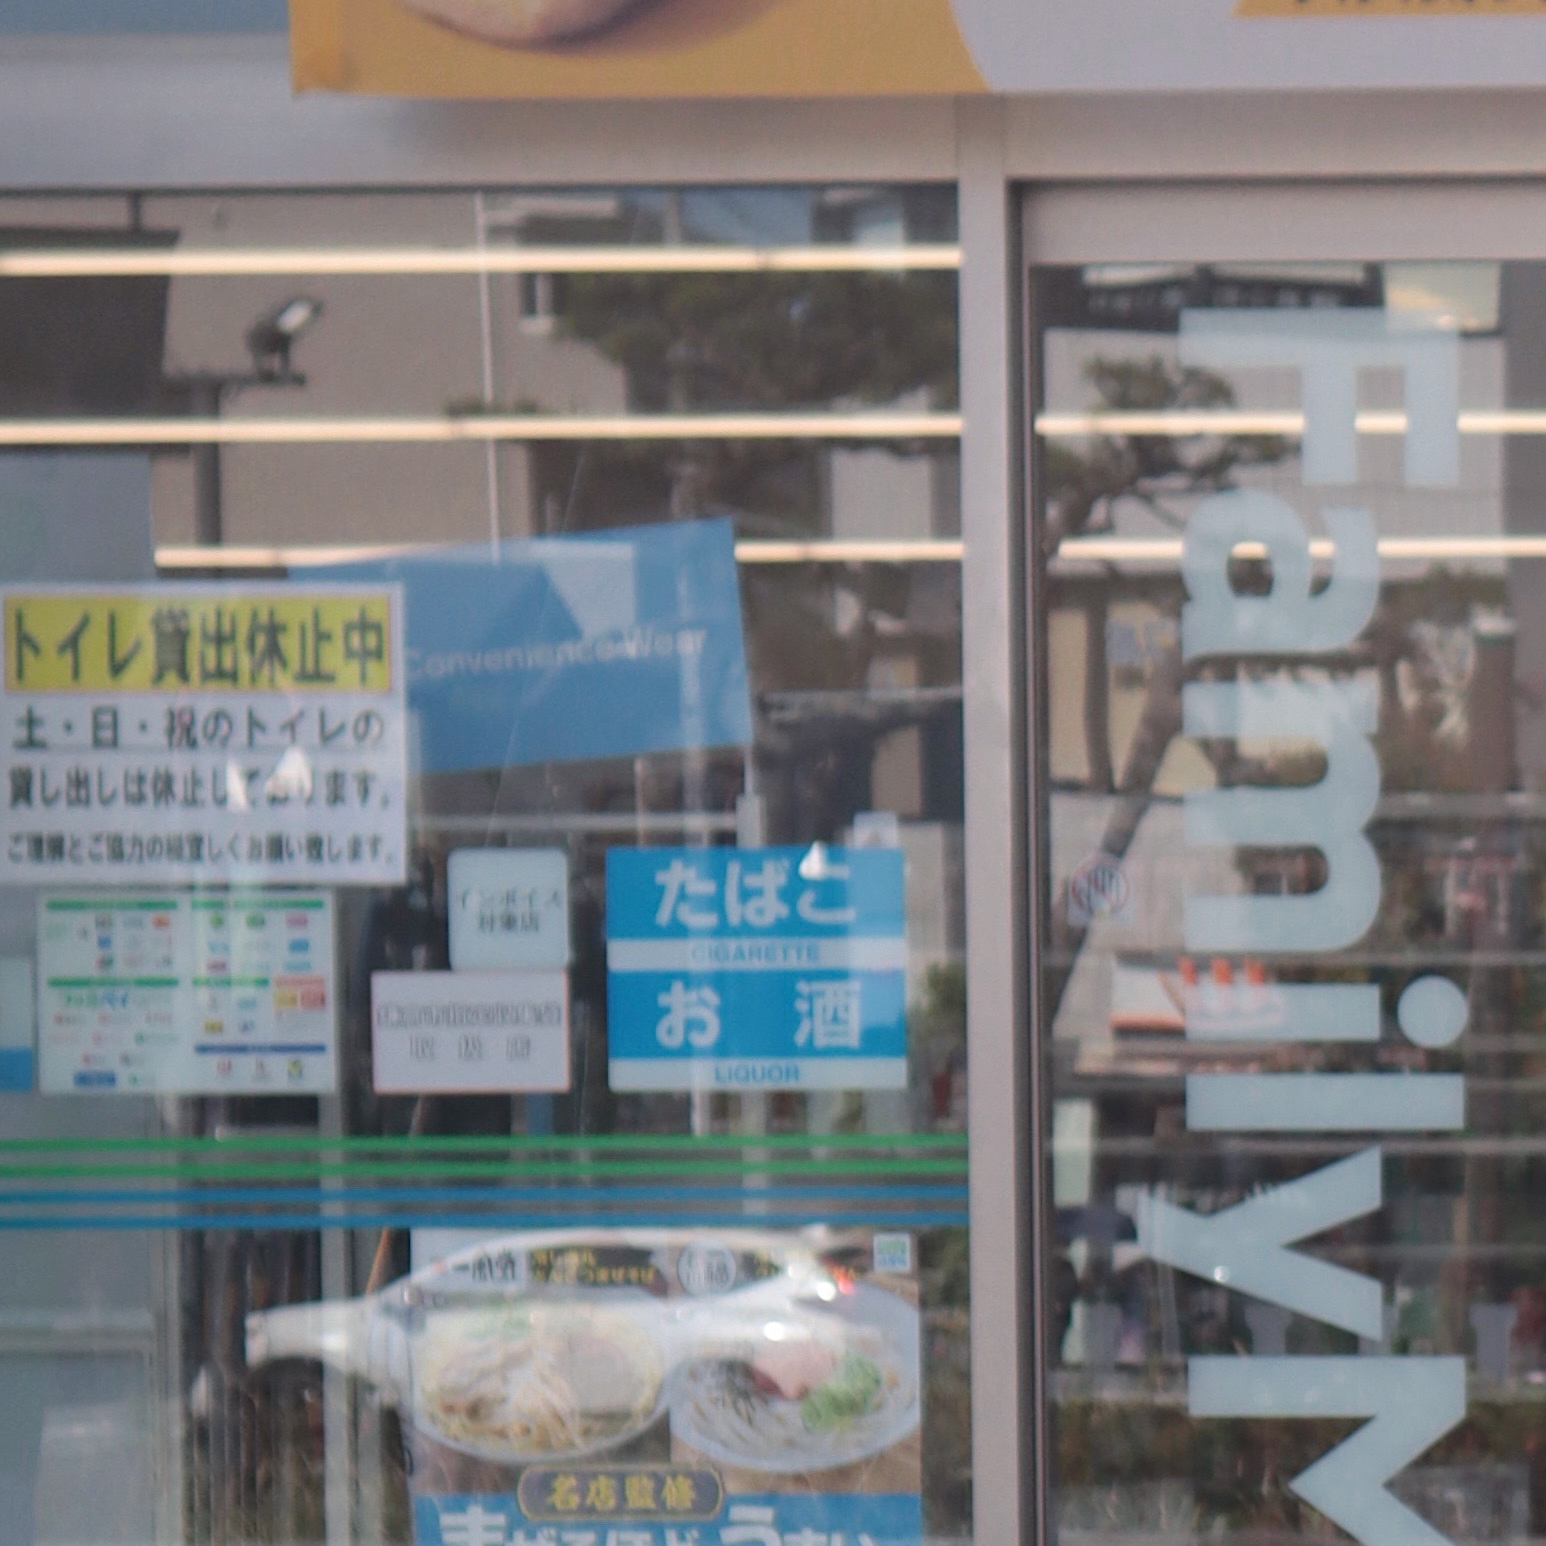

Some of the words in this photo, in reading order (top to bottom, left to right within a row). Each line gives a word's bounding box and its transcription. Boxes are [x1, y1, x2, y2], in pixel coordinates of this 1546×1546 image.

[13, 604, 386, 688] トイレ貸出休止中
[12, 704, 386, 750] 土・日・祝のトイレの
[654, 858, 858, 930] たばこ
[690, 940, 824, 964] CIGARETTE
[654, 980, 864, 1050] お酒
[714, 1064, 802, 1084] LIQUOR
[546, 1474, 696, 1510] 名店監修
